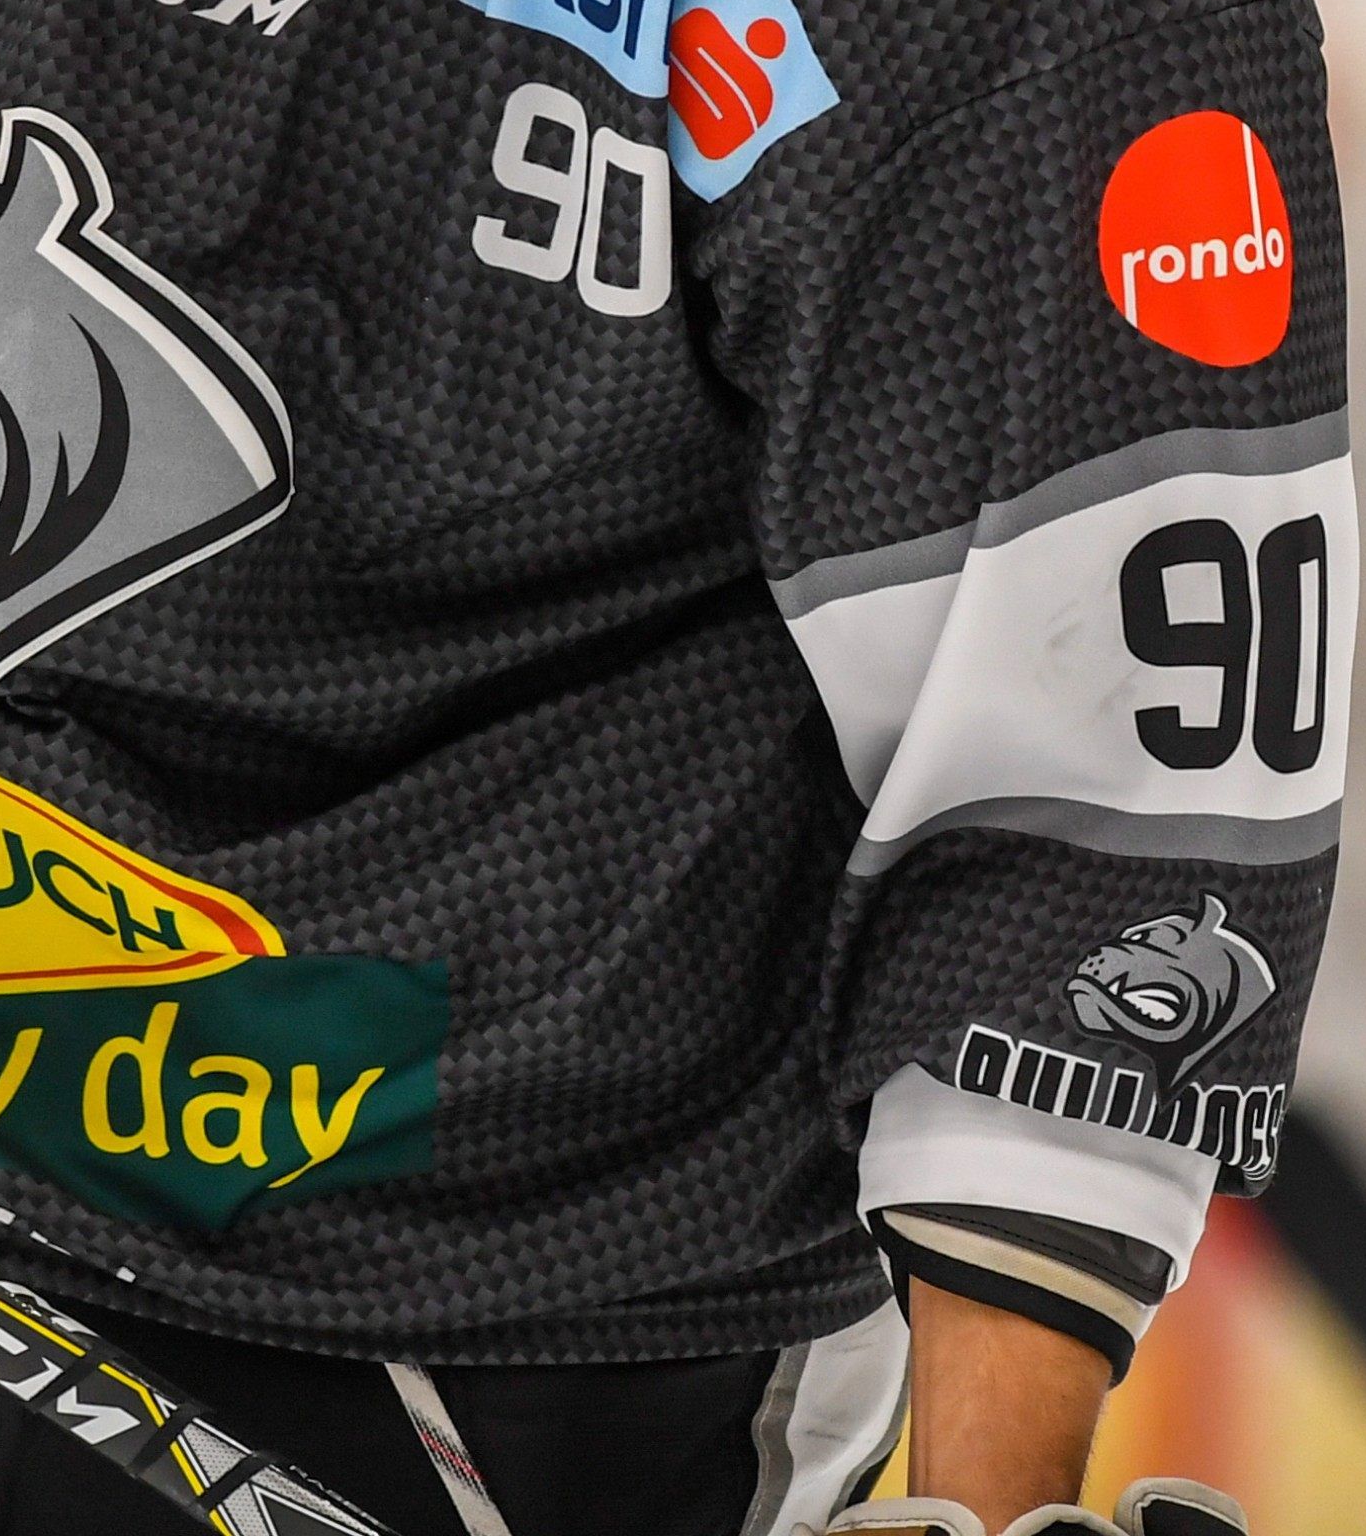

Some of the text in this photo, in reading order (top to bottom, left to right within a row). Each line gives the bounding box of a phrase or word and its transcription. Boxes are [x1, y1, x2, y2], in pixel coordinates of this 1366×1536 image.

[472, 82, 672, 317] 90
[1122, 123, 1284, 328] rondo
[1119, 513, 1329, 774] 90
[82, 1001, 385, 1189] day
